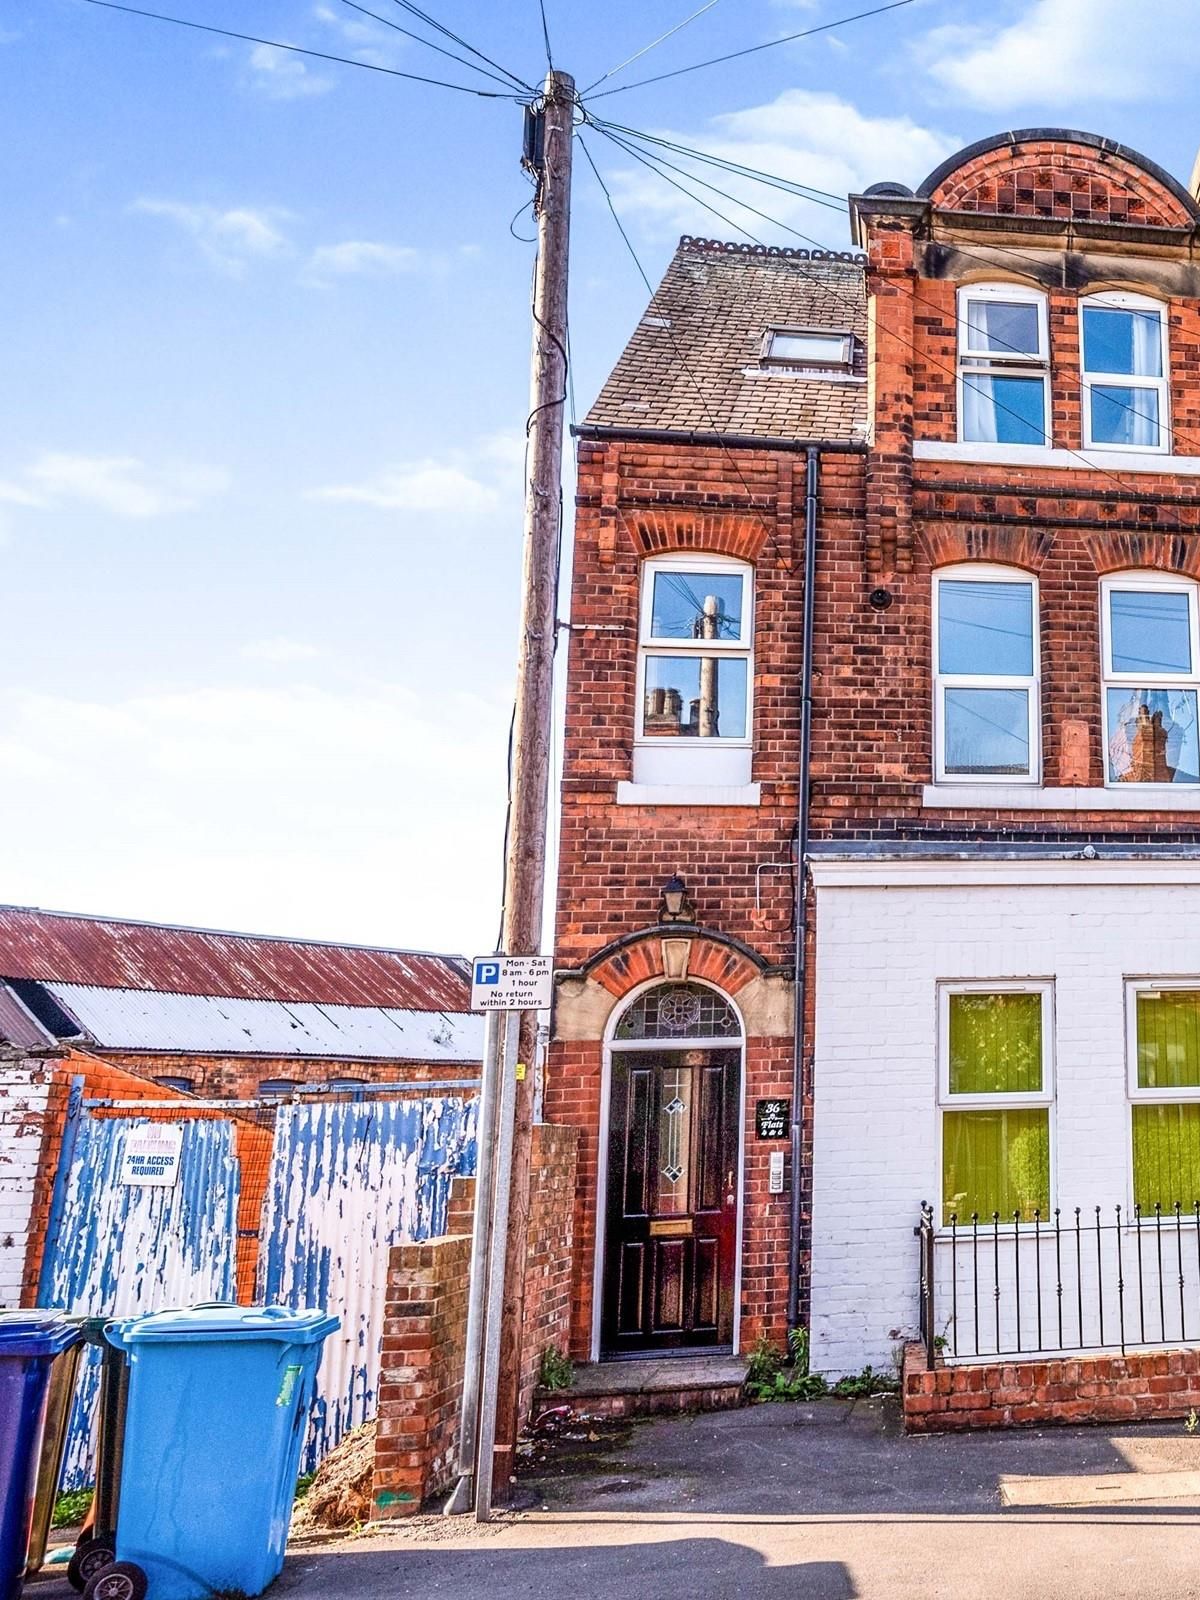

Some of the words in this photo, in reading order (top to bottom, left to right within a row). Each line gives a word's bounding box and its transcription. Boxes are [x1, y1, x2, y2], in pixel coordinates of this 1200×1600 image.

[481, 965, 496, 983] P
[761, 1121, 784, 1129] Flats
[126, 1155, 145, 1165] 24HR
[146, 1156, 175, 1165] ACCESS
[131, 1166, 165, 1176] REQUIRED
